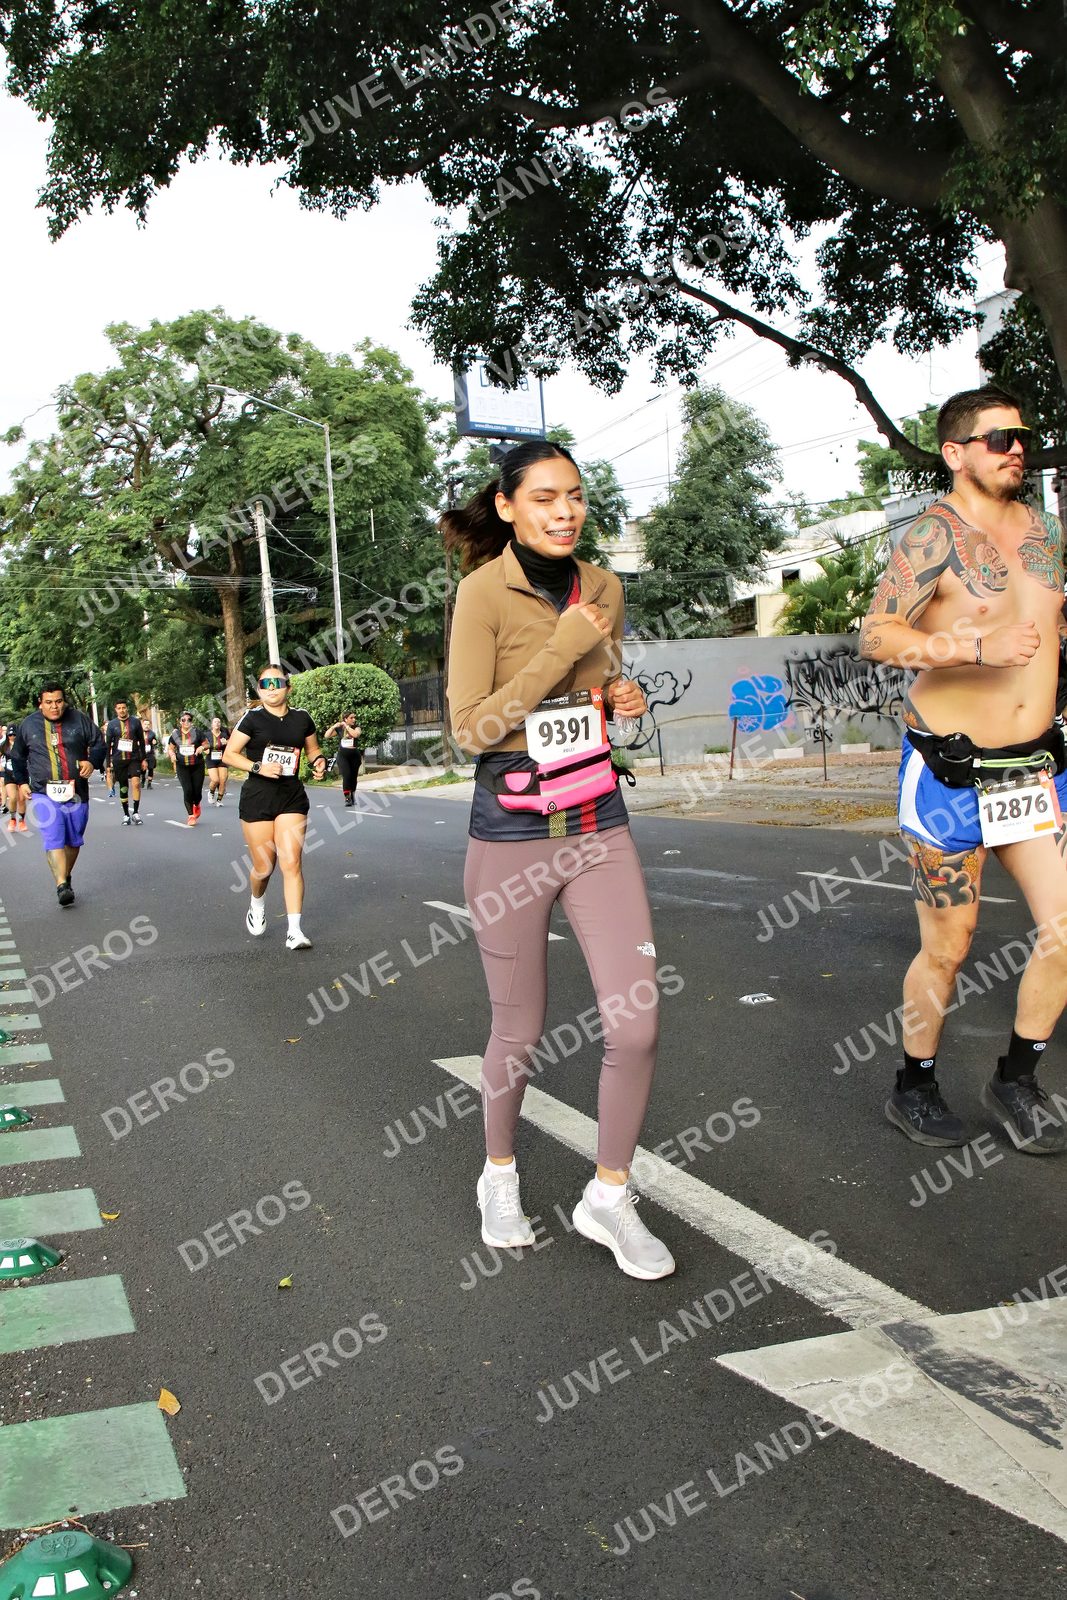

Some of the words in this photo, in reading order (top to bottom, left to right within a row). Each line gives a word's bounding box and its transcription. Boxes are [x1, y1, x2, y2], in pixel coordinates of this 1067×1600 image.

[539, 715, 590, 747] 9391
[267, 752, 292, 766] 8284
[52, 786, 67, 794] 307
[983, 793, 1048, 823] 12876
